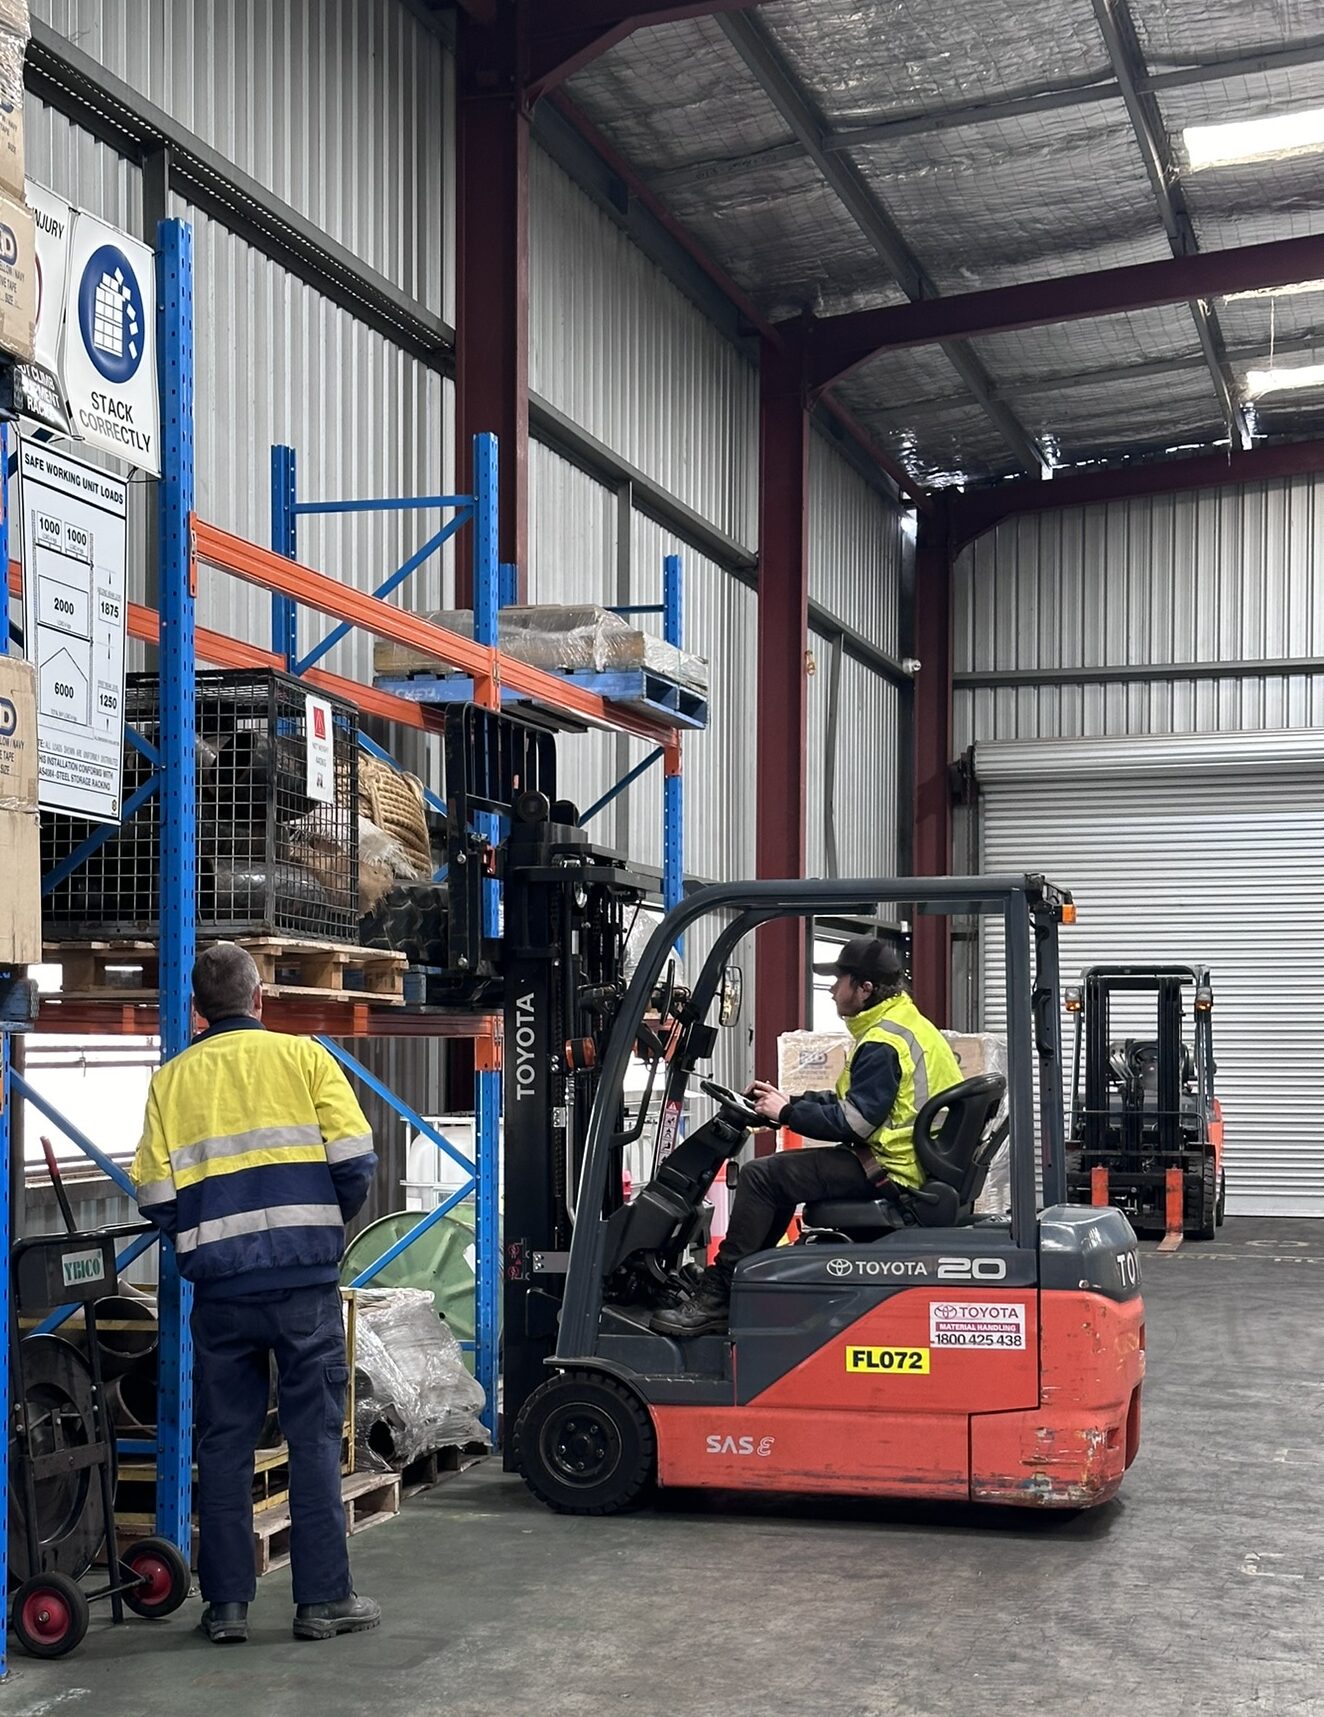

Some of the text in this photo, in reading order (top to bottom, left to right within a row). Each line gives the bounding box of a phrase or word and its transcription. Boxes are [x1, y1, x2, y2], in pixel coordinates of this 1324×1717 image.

[91, 391, 134, 424] STACK
[79, 408, 151, 453] CORRECTLY
[24, 453, 124, 505] SAFE WORKING UNIT LOADS
[39, 517, 60, 535] 1000
[67, 528, 87, 546] 1000
[54, 597, 74, 615] 2000
[101, 601, 119, 618] 1875
[54, 682, 74, 699] 6000
[99, 693, 117, 710] 1250
[47, 757, 78, 772] INSTALLATION
[78, 765, 102, 778] CONFORMS
[70, 774, 91, 787] STORAGE
[91, 780, 111, 791] RACKING
[516, 991, 535, 1101] TOYOTA
[855, 1257, 1007, 1280] TOYOTA 20
[1116, 1250, 1141, 1288] TO
[959, 1306, 1019, 1320] TOYOTA
[939, 1323, 1017, 1333] MATERIAL HANDLING
[935, 1334, 1022, 1347] 1800 425 438
[852, 1350, 923, 1369] FL072
[706, 1435, 754, 1455] SAS
